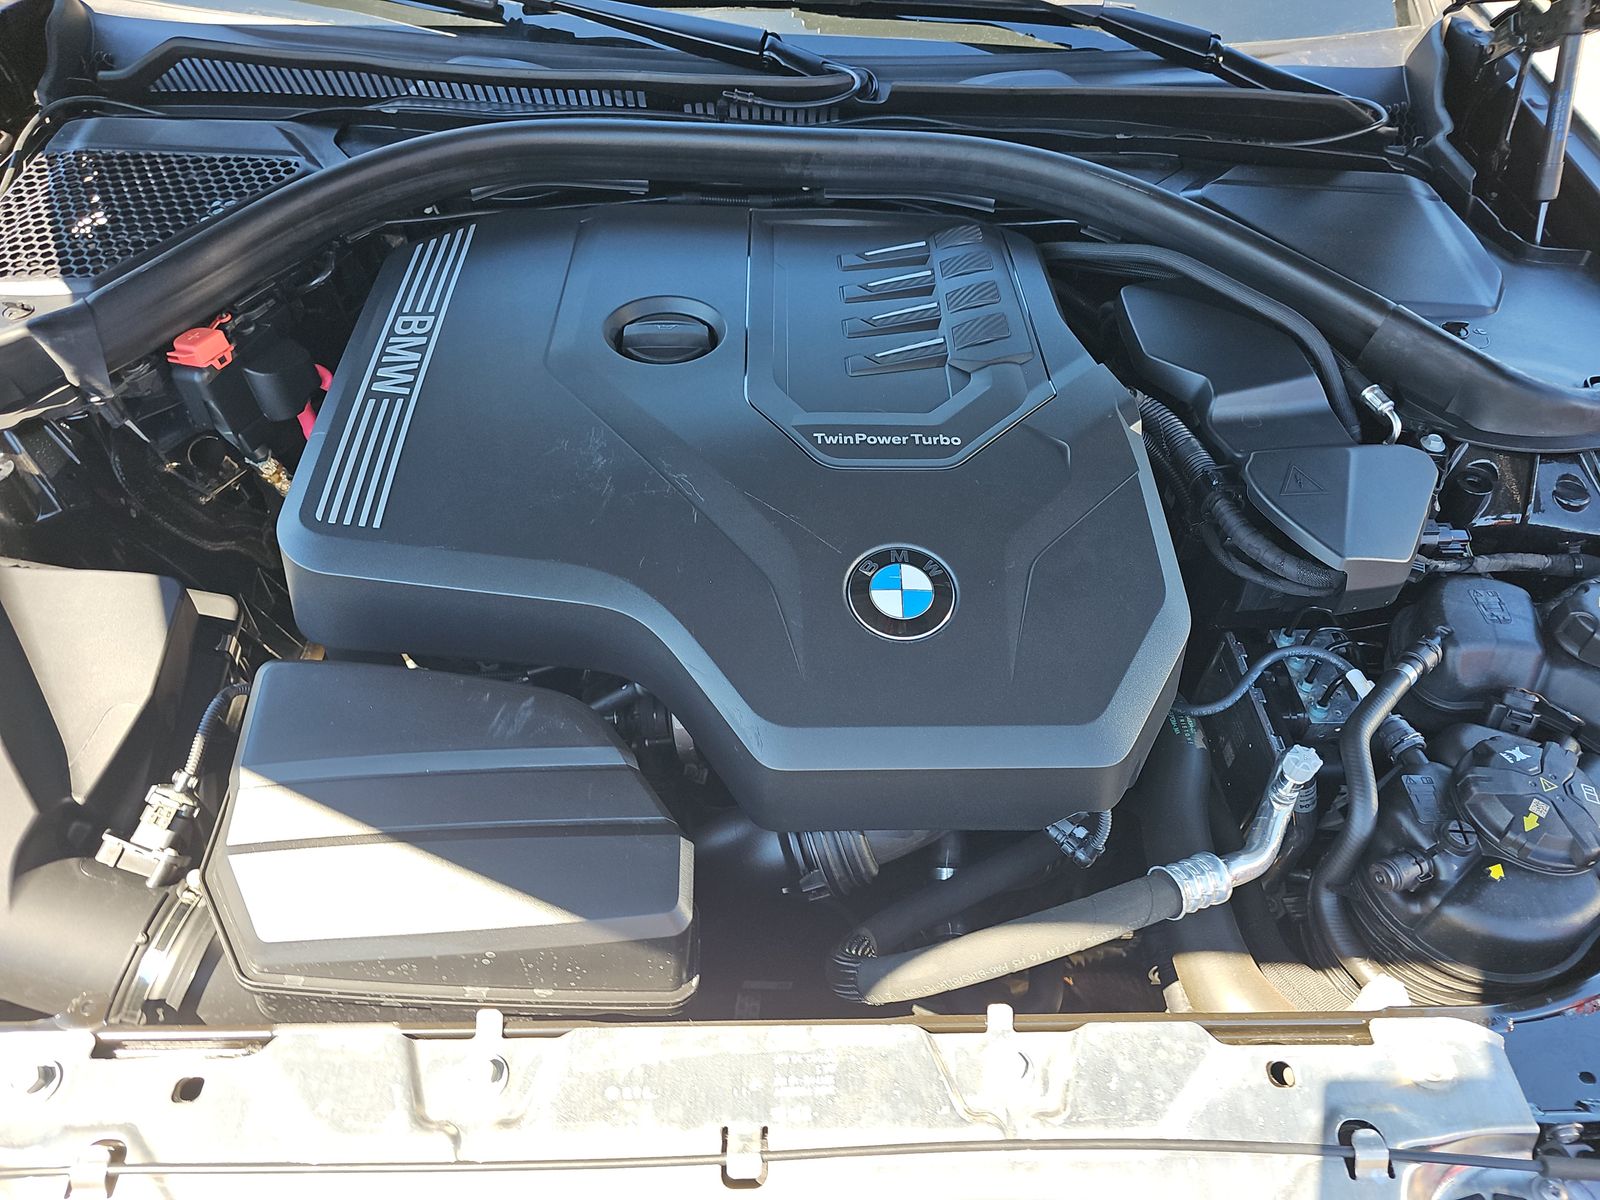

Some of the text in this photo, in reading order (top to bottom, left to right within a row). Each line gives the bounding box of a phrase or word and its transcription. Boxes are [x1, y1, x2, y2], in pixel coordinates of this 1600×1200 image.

[371, 315, 436, 395] BMW
[910, 433, 961, 446] Turbo
[858, 549, 944, 577] BMW
